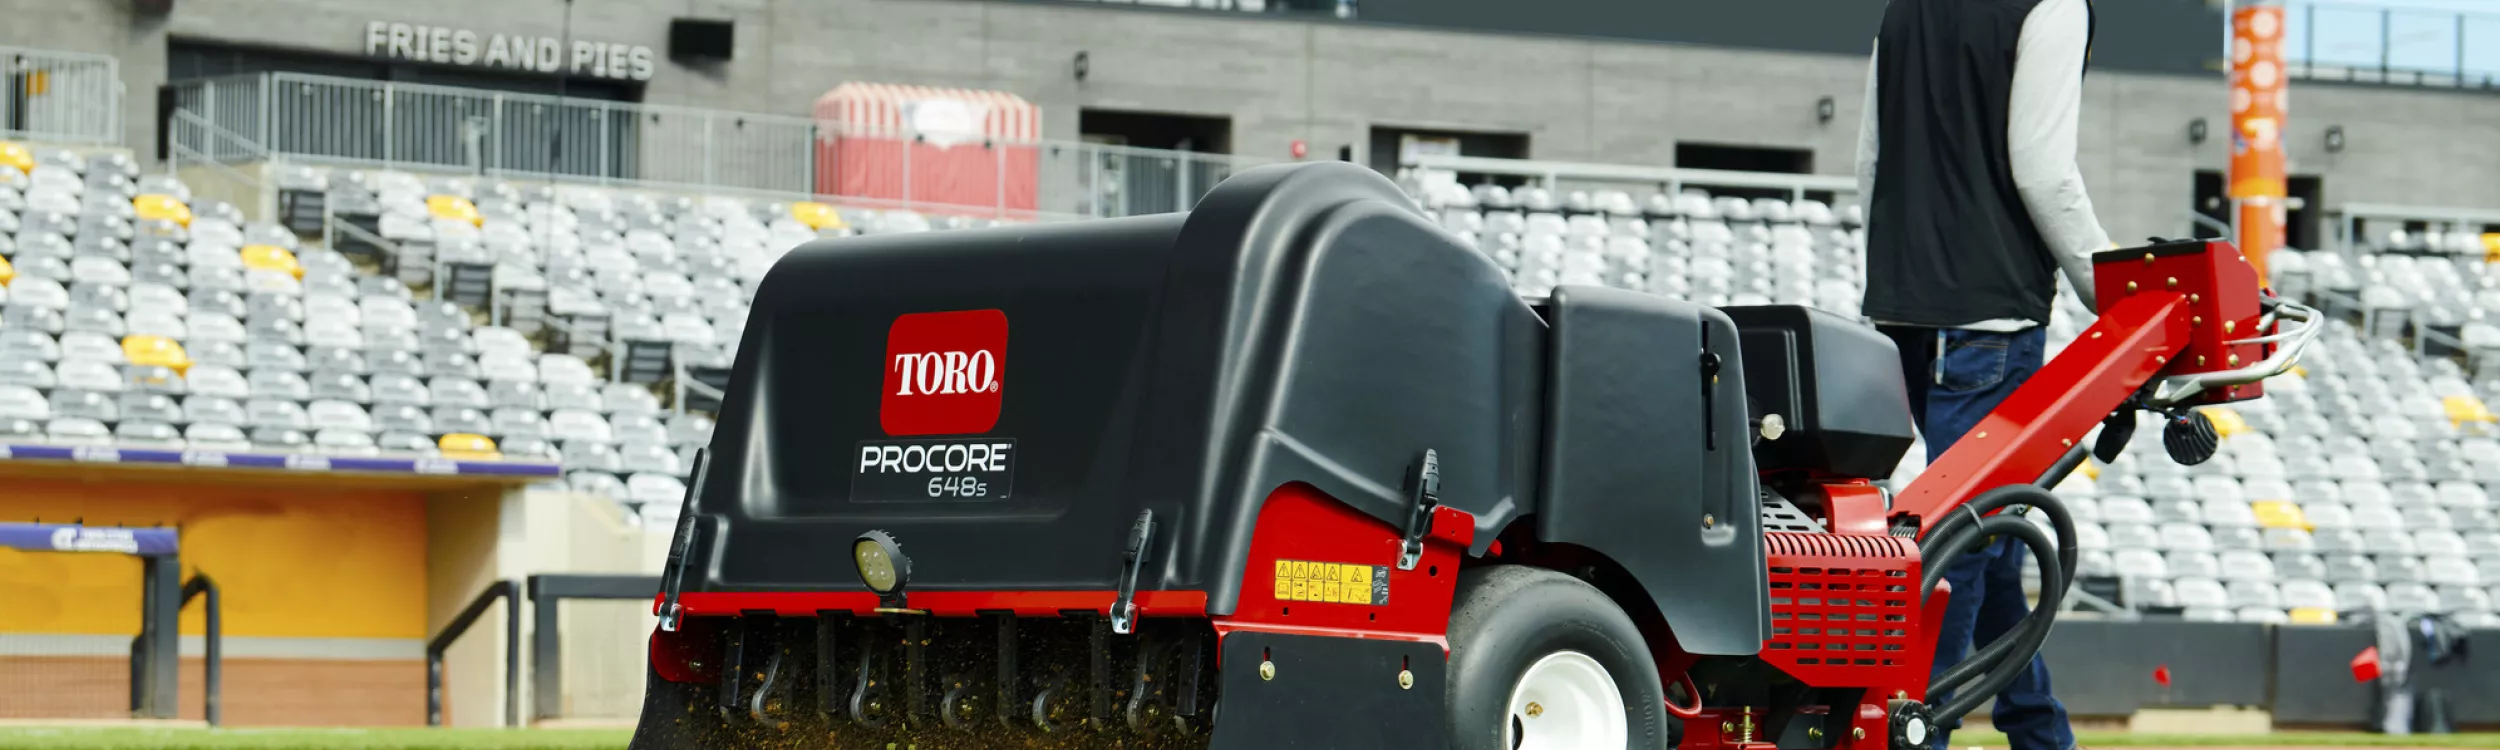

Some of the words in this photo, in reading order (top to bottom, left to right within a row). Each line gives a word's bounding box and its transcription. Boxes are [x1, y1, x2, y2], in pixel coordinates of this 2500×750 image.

[366, 20, 477, 65] FRIES
[483, 32, 561, 72] AND
[570, 40, 654, 81] PIES
[927, 476, 987, 497] 648s
